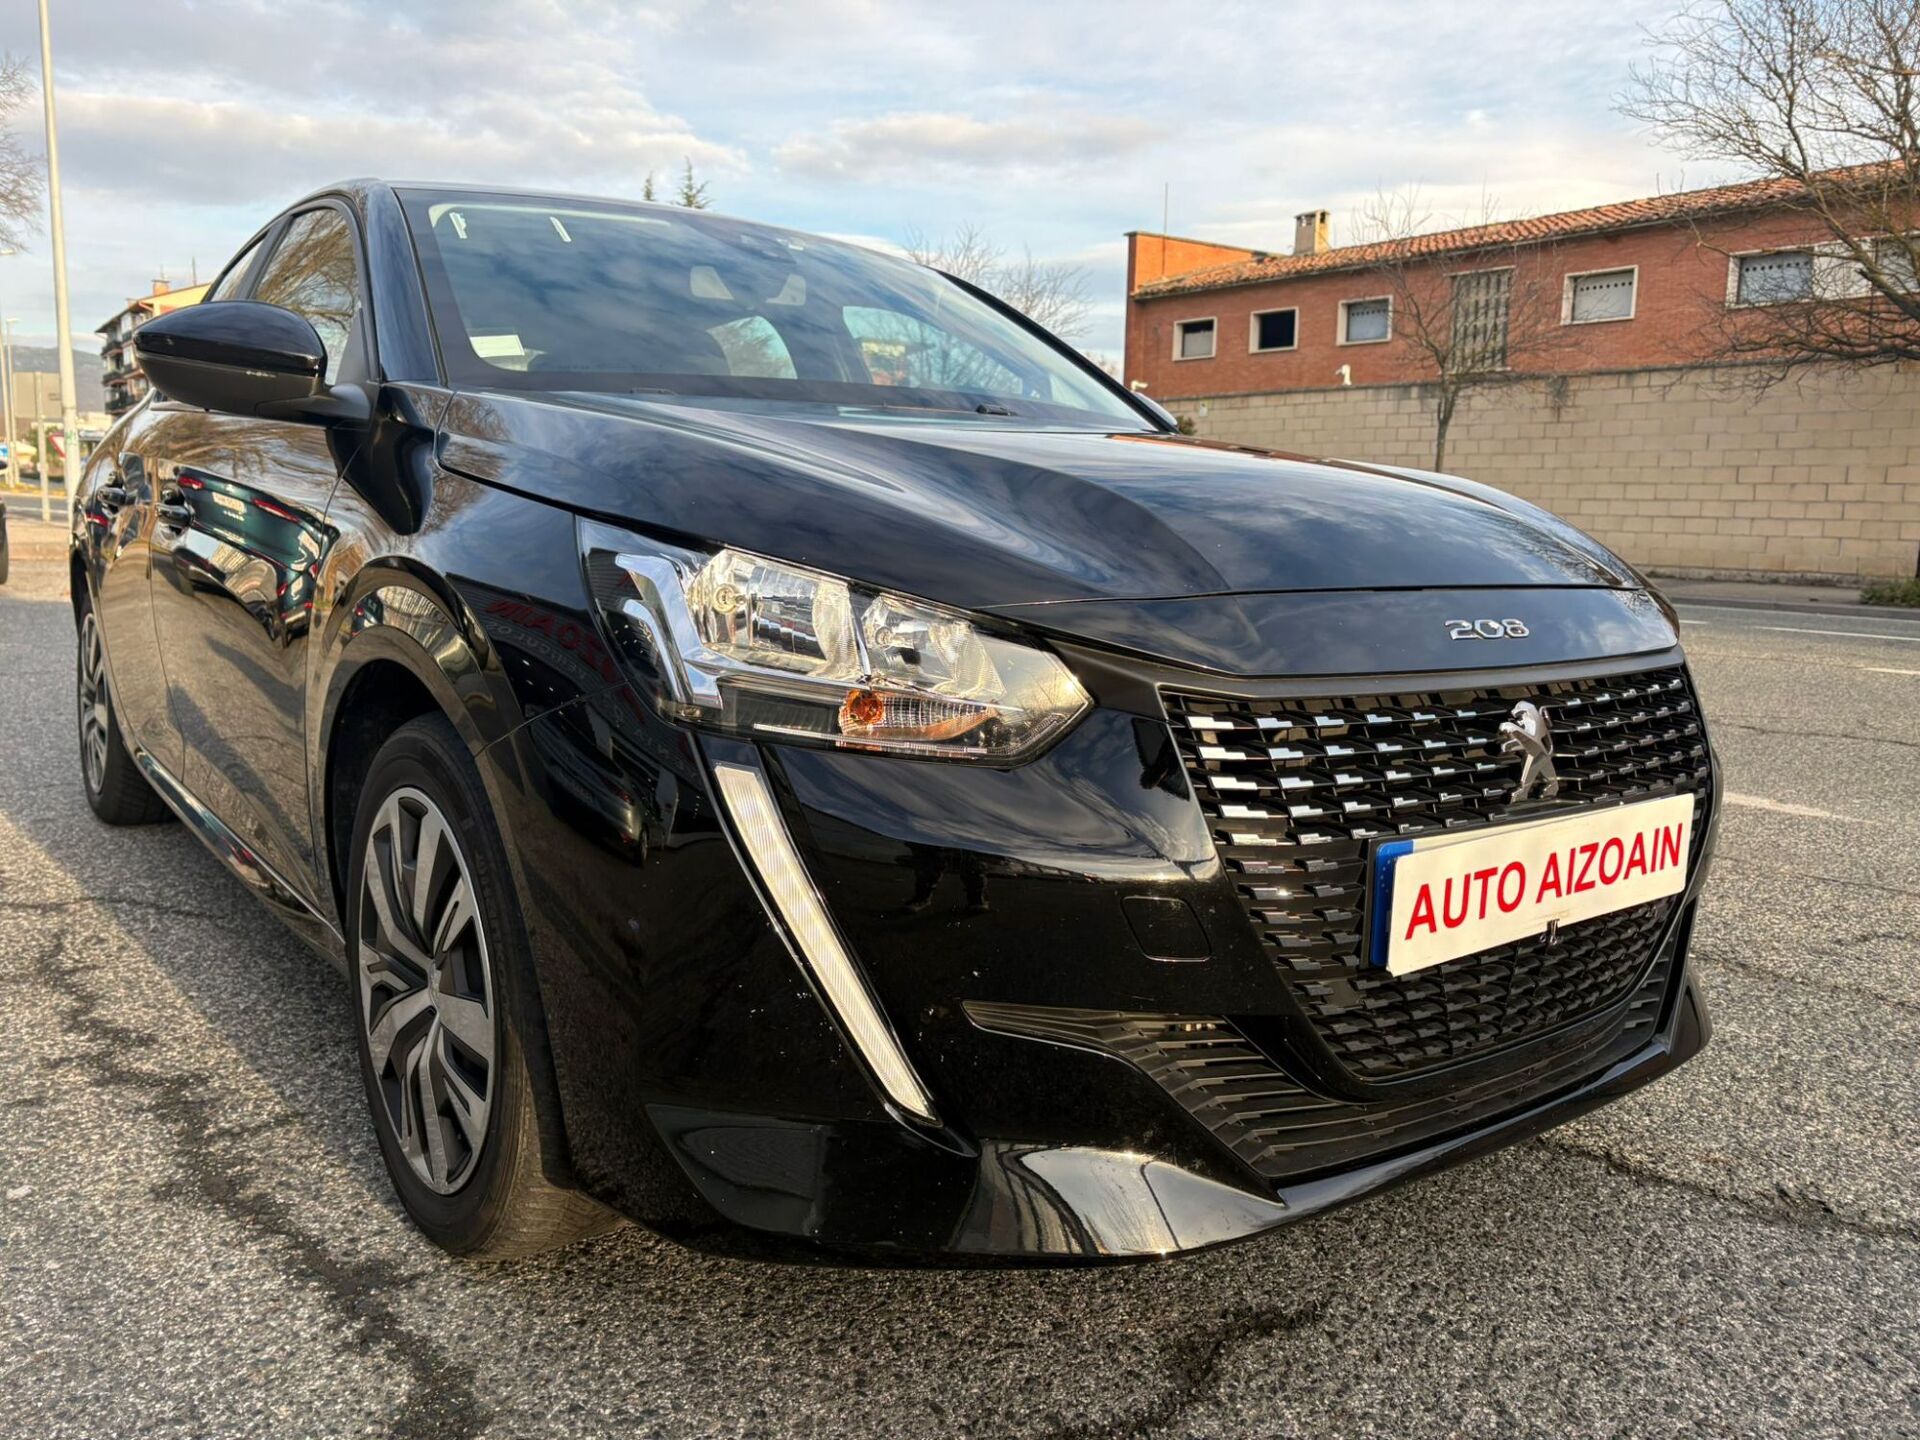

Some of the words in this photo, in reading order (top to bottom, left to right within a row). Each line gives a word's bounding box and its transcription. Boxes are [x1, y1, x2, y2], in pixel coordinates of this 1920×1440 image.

[1445, 618, 1530, 640] 208
[1404, 861, 1527, 941] AUTO
[1535, 822, 1683, 904] AIZOAIN
